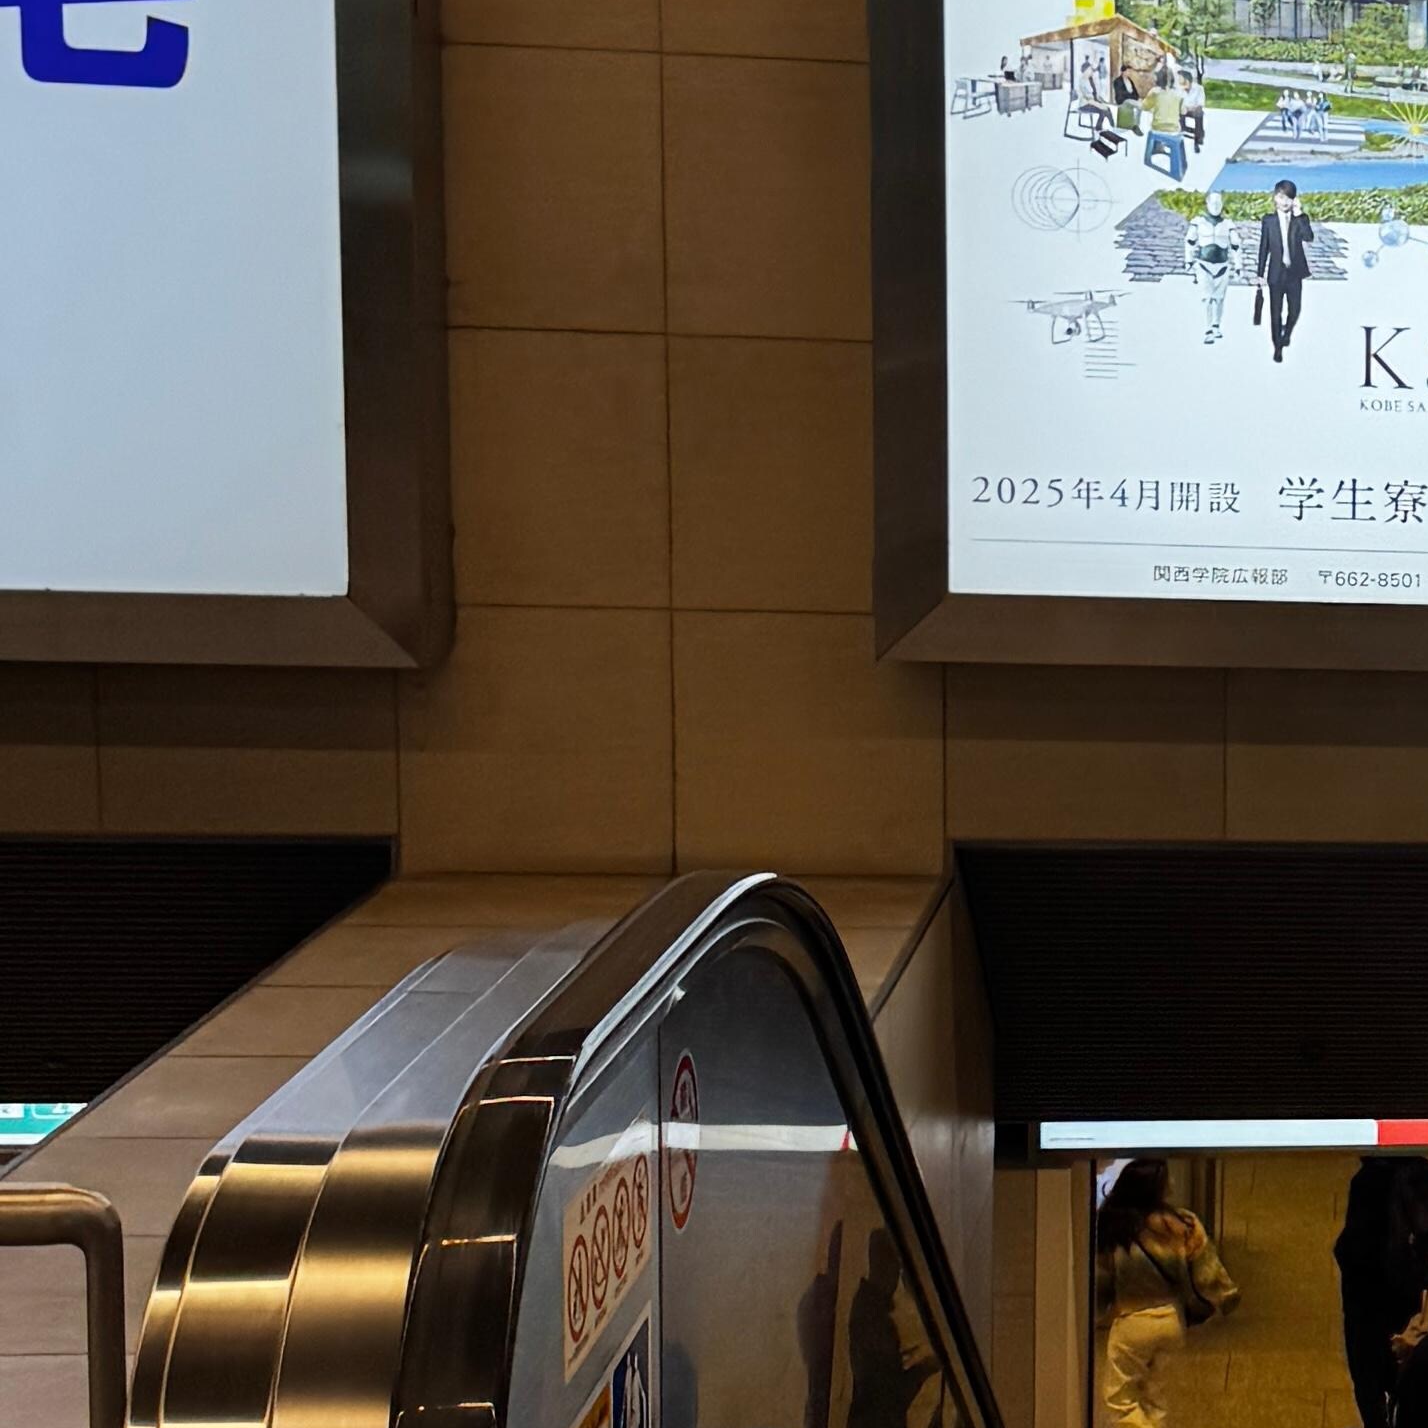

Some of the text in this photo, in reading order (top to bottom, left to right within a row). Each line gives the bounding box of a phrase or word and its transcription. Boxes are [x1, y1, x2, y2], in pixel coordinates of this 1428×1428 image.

[1360, 399, 1402, 412] KOBE
[971, 475, 1241, 514] 2025年4月開設
[1278, 476, 1428, 525] 学生寮
[1153, 564, 1289, 586] 関西学院広報部
[1319, 570, 1421, 589] 〒662-8501
